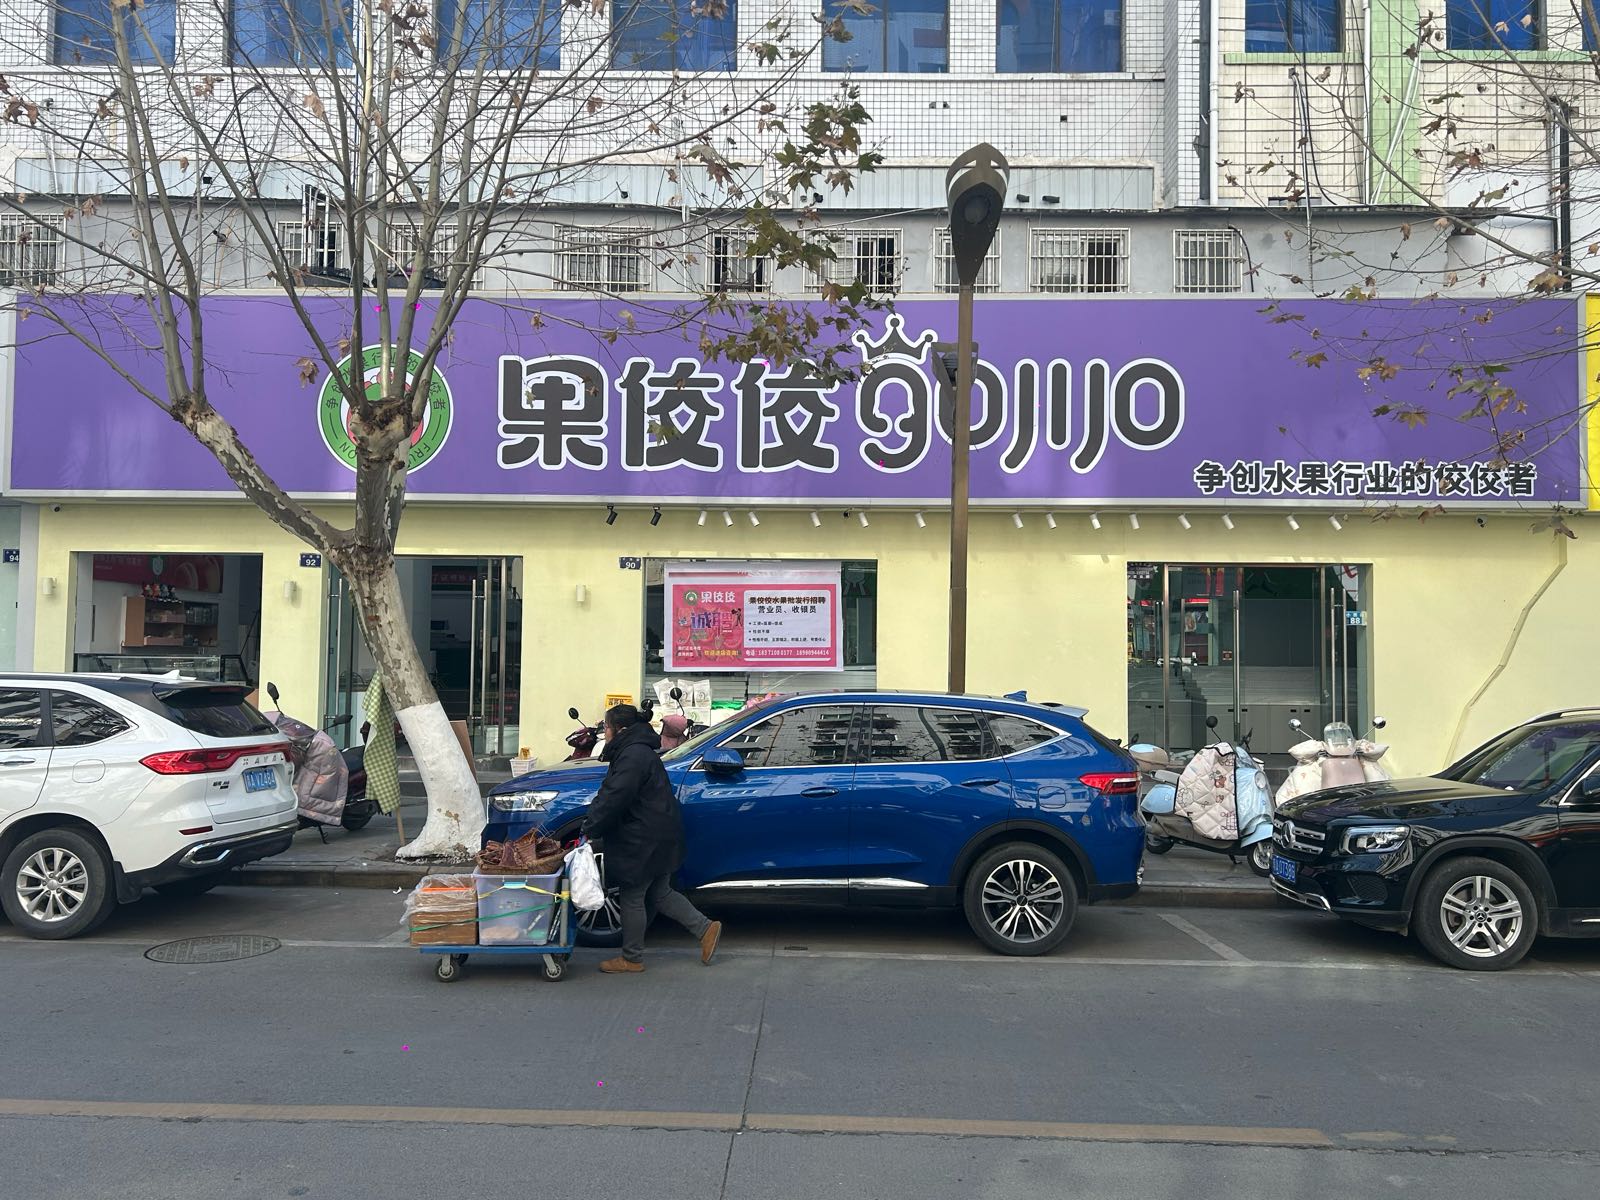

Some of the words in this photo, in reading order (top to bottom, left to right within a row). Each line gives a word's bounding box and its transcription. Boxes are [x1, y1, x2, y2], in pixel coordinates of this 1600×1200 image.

[498, 355, 839, 472] 果佼佼
[1194, 460, 1536, 496] 争创水果行业的佼佼者
[9, 554, 19, 562] 94
[305, 558, 316, 566] 92
[625, 561, 636, 569] 90
[701, 591, 736, 603] 果佼佼
[749, 596, 826, 605] 果佼佼水果批发行招聘
[758, 605, 817, 614] 营业员、收银员
[691, 611, 732, 636] 诚聘
[243, 755, 284, 766] HAVAL
